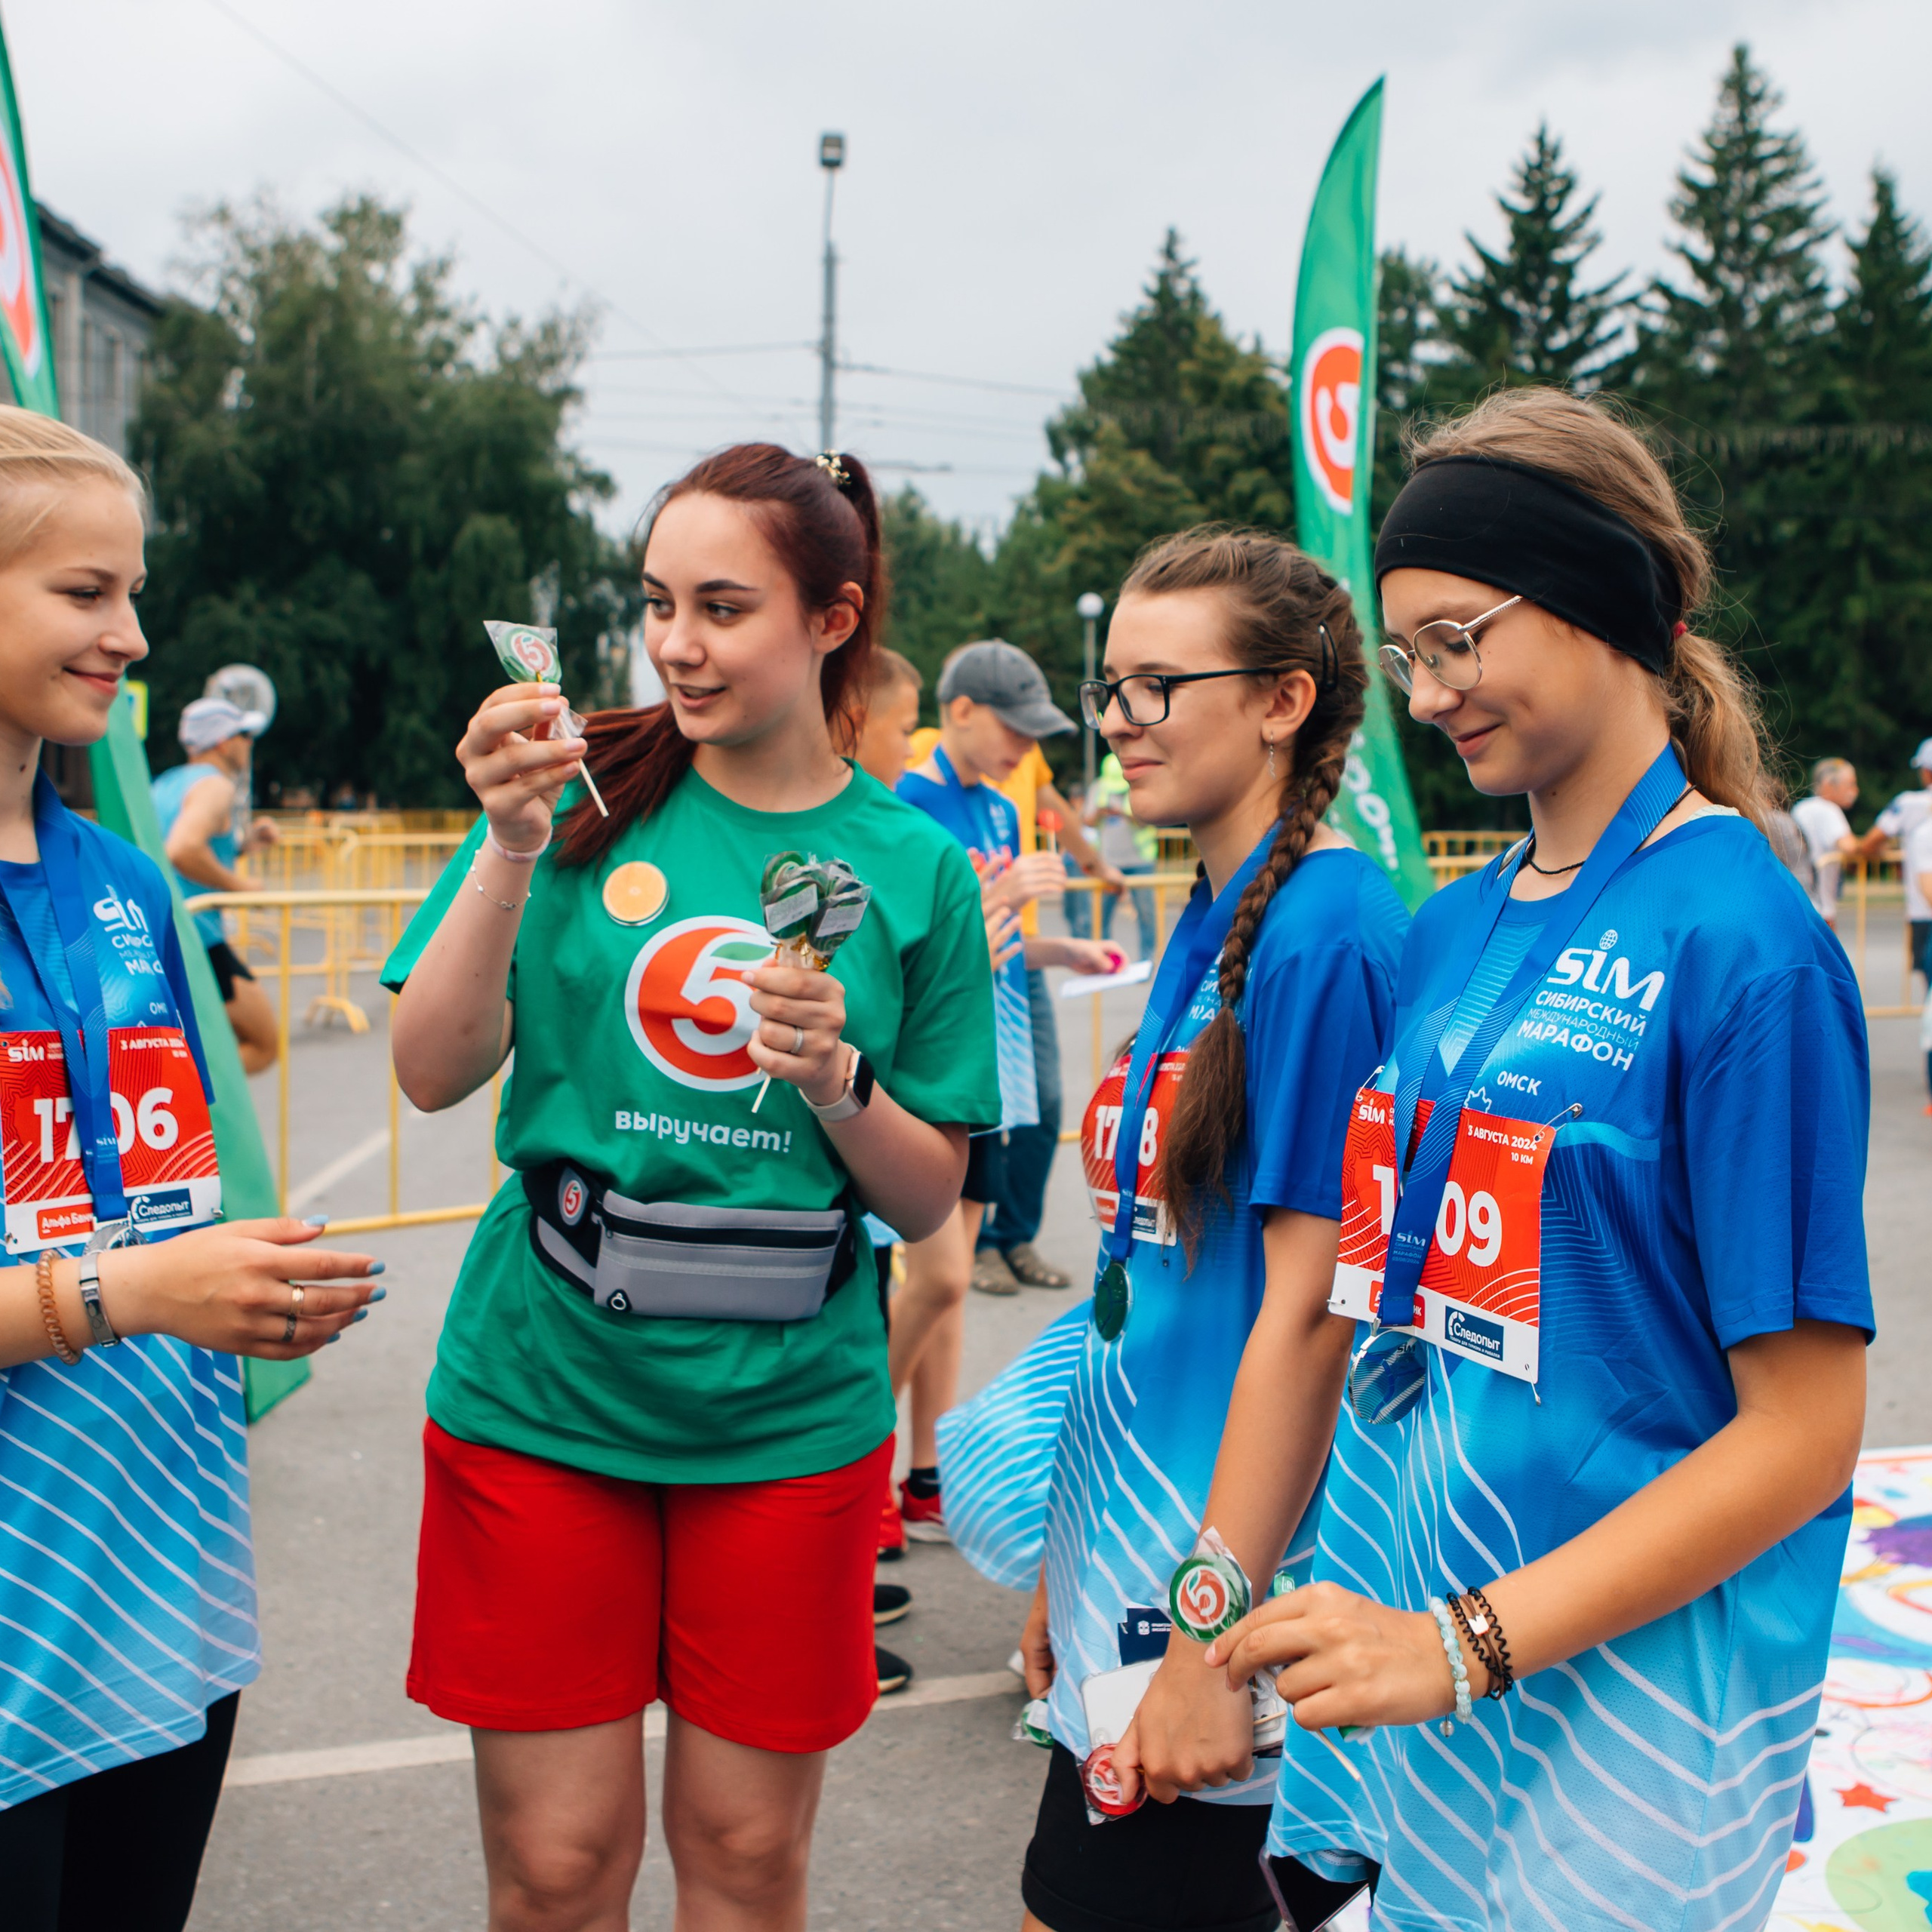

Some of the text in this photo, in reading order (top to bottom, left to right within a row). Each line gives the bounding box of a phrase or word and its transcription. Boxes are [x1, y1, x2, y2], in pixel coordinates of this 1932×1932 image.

[1535, 990, 1647, 1036] СИБИРСКИЙ
[1527, 1008, 1639, 1051] МЕЖДУНАРОДНЫЙ
[120, 1039, 128, 1051] 3
[1517, 1020, 1634, 1071] МАРАФОН
[1497, 1071, 1542, 1096] ОМСК
[615, 1110, 792, 1152] выручает!
[1095, 1105, 1159, 1167] 178
[1468, 1124, 1537, 1151] 3 АВГУСТА 2024
[1511, 1152, 1534, 1164] 10 КМ
[138, 1201, 189, 1217] Следопыт
[1373, 1164, 1503, 1267] 109
[1393, 1250, 1422, 1259] МАРАФОН
[1454, 1322, 1500, 1351] Следопыт
